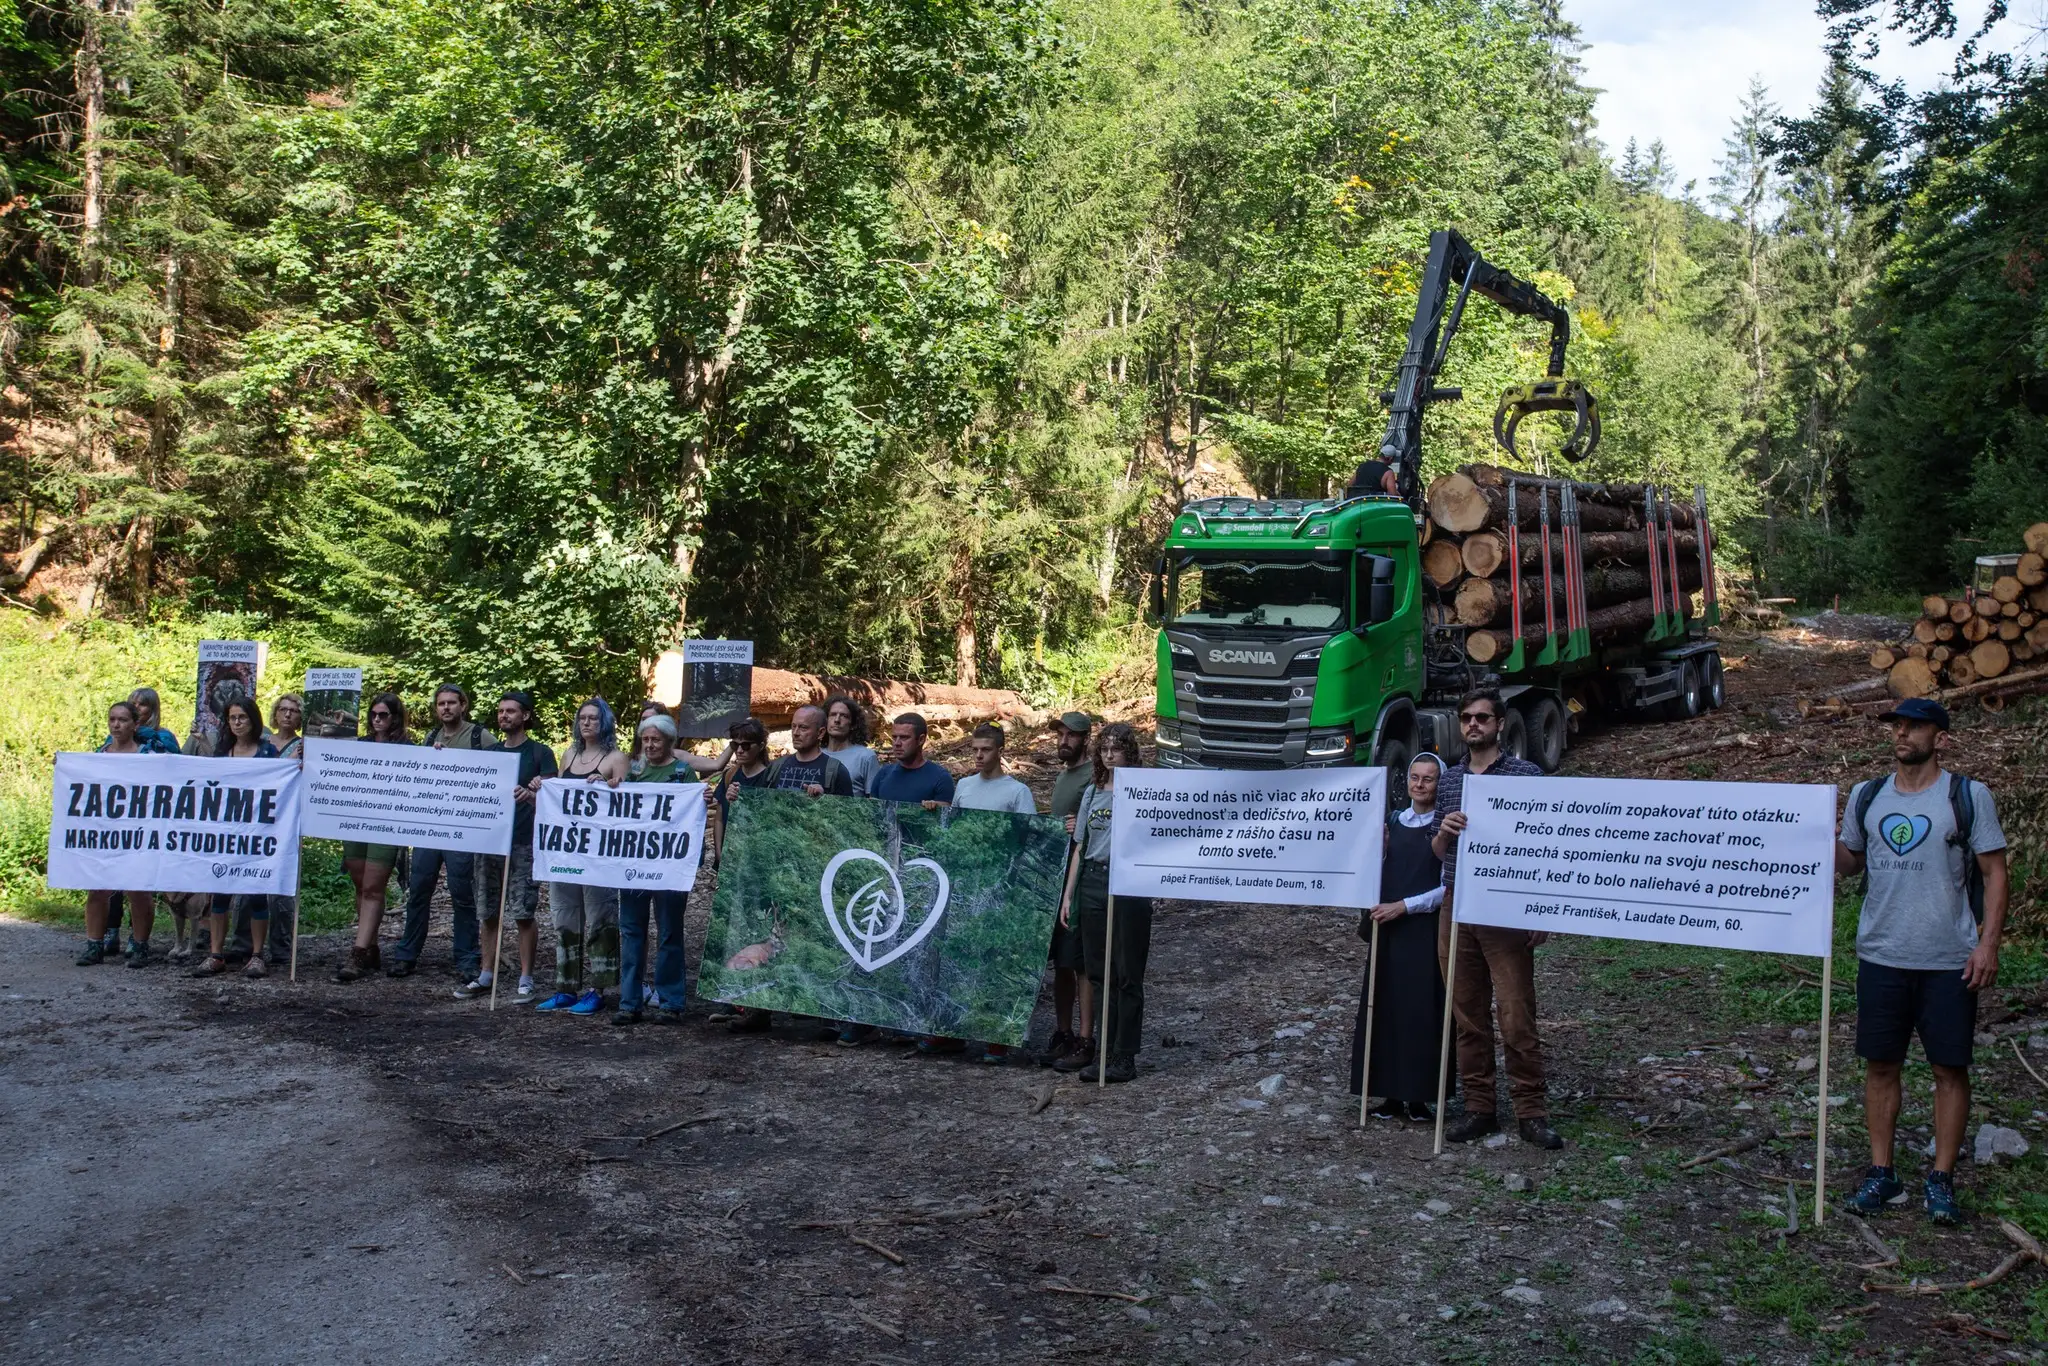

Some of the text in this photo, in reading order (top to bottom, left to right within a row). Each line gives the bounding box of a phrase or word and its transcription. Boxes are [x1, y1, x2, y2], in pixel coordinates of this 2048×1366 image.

[1208, 649, 1277, 665] SCANIA
[320, 768, 496, 790] výsmechom, ktorý túto tému prezentuje ako
[391, 760, 422, 771] navždy
[430, 764, 498, 776] nezodpovedným
[67, 780, 277, 824] ZACHRÁŇME
[310, 782, 339, 791] výlučne
[341, 784, 411, 799] environmentálnu,
[452, 794, 501, 806] romantickú,
[1124, 787, 1371, 803] "Nežiada sa od nás nič viac ako určitá
[309, 795, 329, 805] často
[330, 799, 393, 810] zosmiešňovanú
[394, 804, 454, 817] ekonomickými
[562, 789, 675, 822] LES NIE JE
[1135, 806, 1226, 823] zodpovednosť
[1243, 807, 1309, 823] dedičstvo,
[1314, 808, 1353, 822] ktoré
[1488, 797, 1800, 823] "Mocným si dovolím zopakovať túto otázku:
[65, 826, 278, 857] MARKOVÚ A STUDIENEC
[339, 822, 463, 839] pápež František, Laudate Deum, 58.
[538, 822, 690, 860] VAŠE IHRISKO
[1150, 825, 1335, 841] zanecháme z nášho času na
[1514, 821, 1765, 850] Prečo dnes chceme zachovať moc,
[1198, 845, 1285, 859] tomto svete."
[1468, 841, 1821, 876] ktorá zanechá spomienku na svoju neschopnosť
[229, 867, 242, 877] MY
[243, 868, 259, 878] SME
[550, 866, 585, 875] GREENPEACE
[1880, 860, 1925, 871] MY SME LES
[1160, 873, 1325, 890] pápež František, Laudate Deum, 18.
[1473, 865, 1810, 900] zasiahnuť, keď to bolo naliehavé a potrebné?"
[1524, 902, 1743, 931] pápež František, Laudate Deum, 60.
